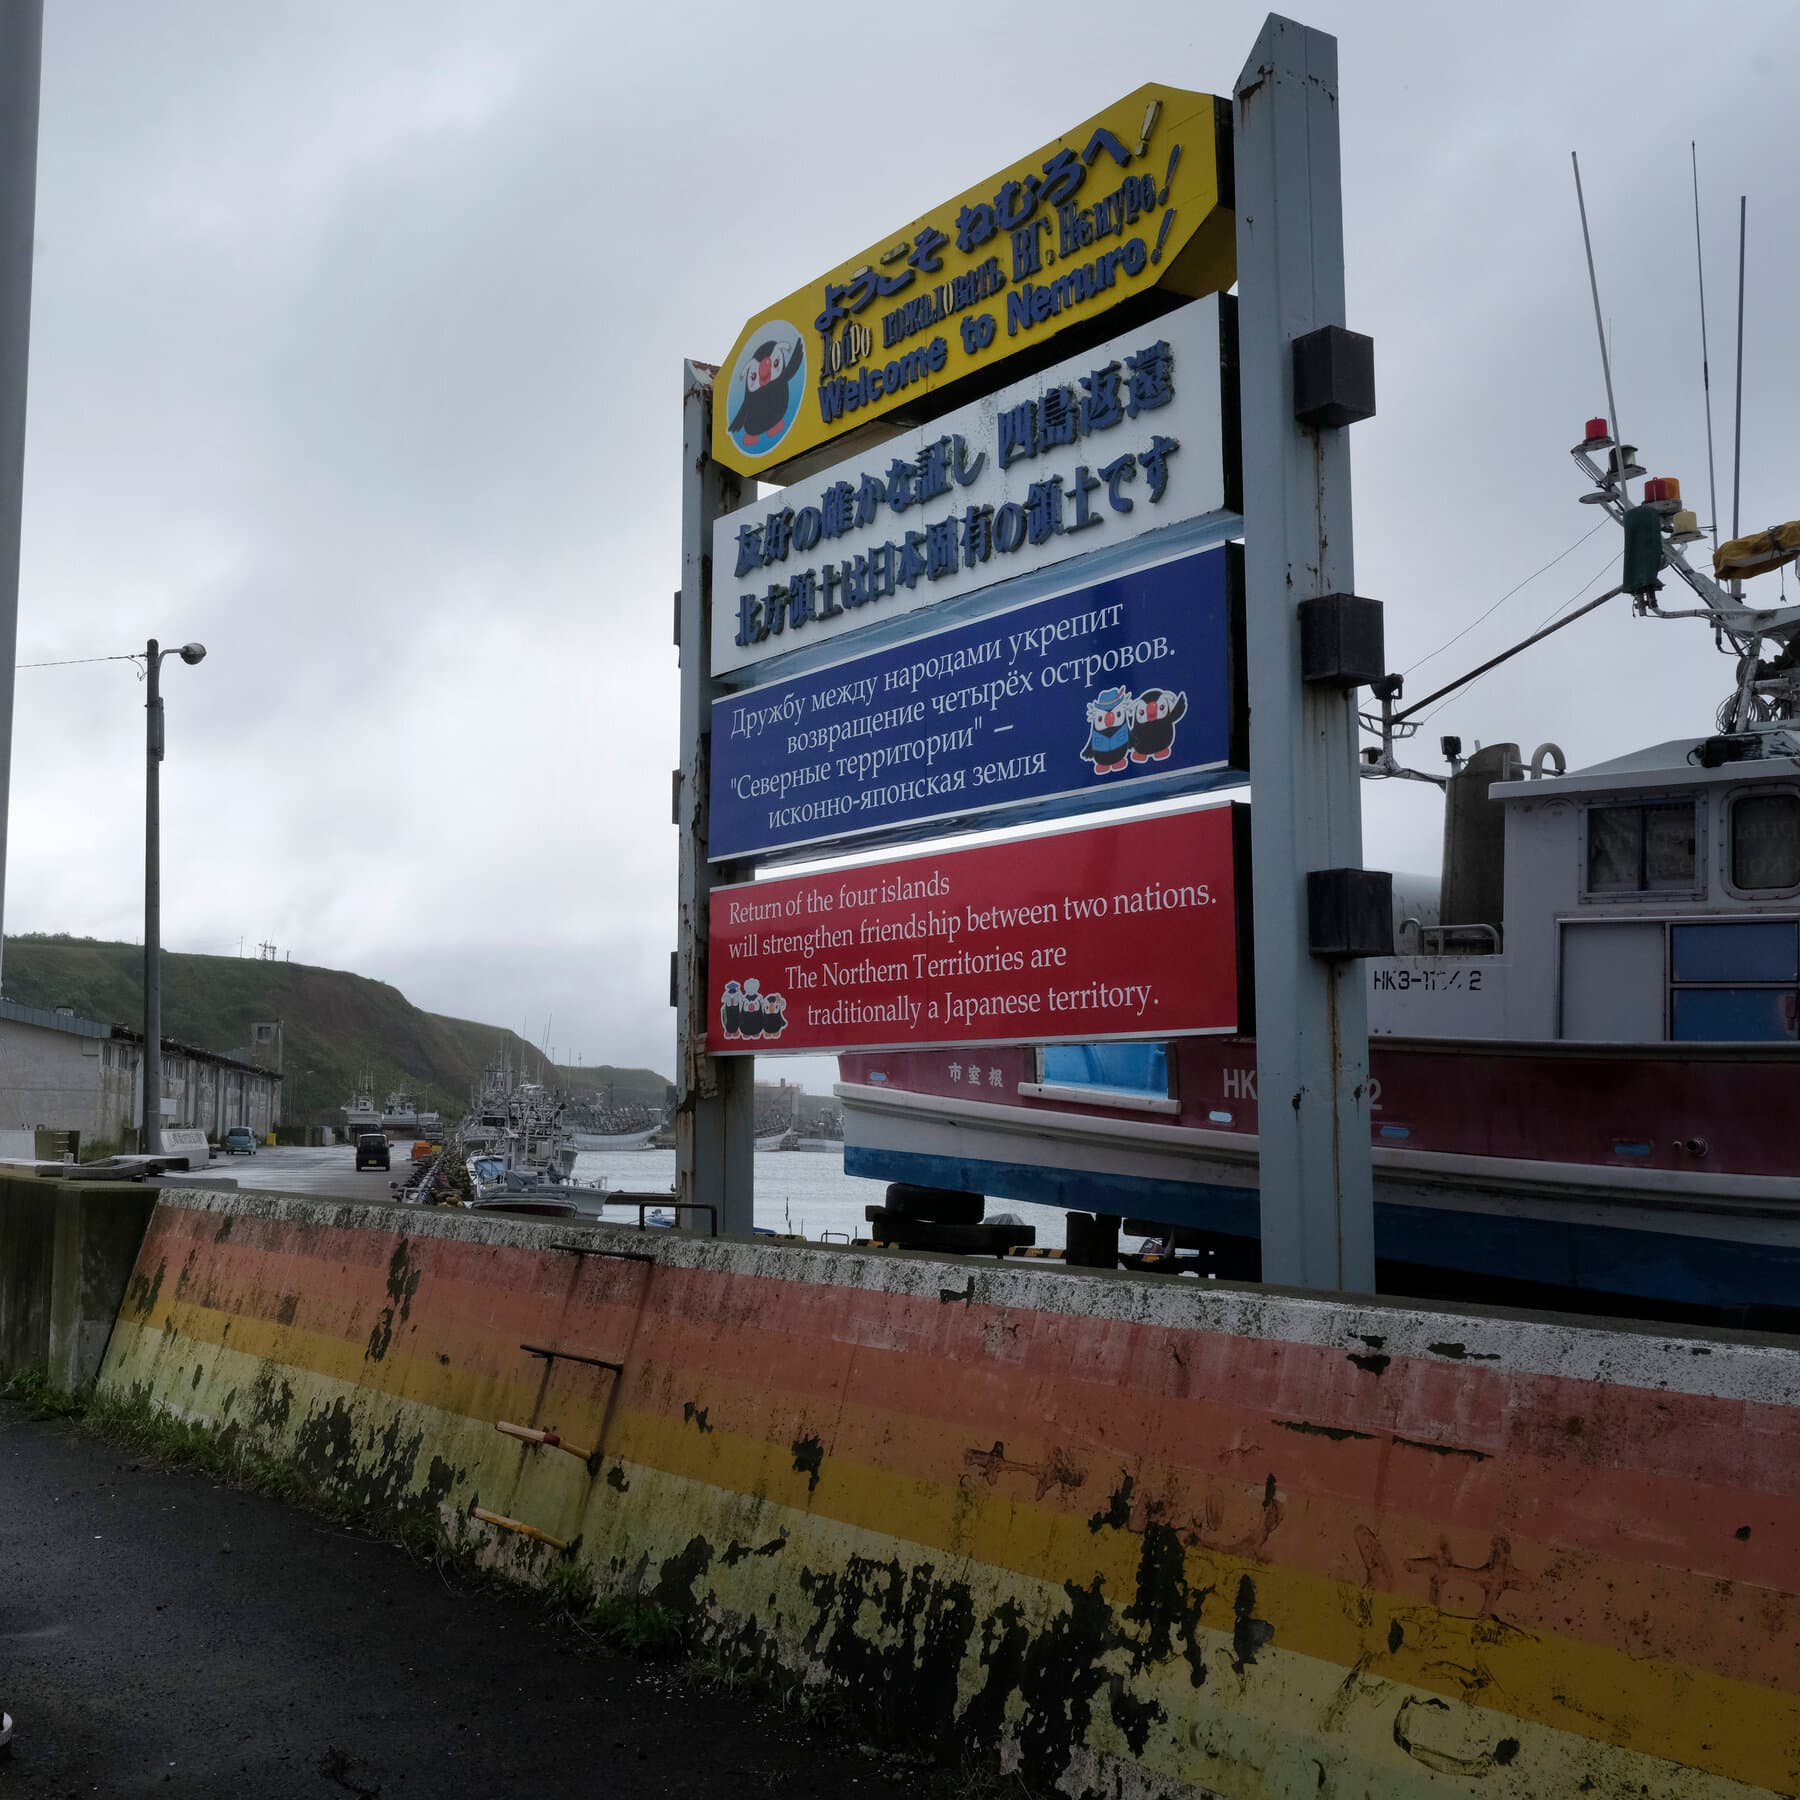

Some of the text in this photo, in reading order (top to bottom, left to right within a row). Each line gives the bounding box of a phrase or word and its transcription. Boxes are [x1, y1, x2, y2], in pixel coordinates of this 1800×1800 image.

[814, 225, 950, 334] ようこそ
[817, 207, 1178, 424] Welcome to Nemuro!
[997, 340, 1177, 472] 四島返還
[734, 436, 1181, 647] 北方領土は日本固有の領土です
[730, 603, 1123, 739] Дружбу между народами укрепит
[787, 637, 1175, 754] возвращение четырёх островов.
[731, 762, 831, 800] "Северные
[836, 716, 982, 782] территории"
[769, 752, 1046, 829] исконно-японская земля
[729, 869, 950, 925] Return of the four islands
[729, 881, 1217, 959] will strengthen friendship between two nations.
[785, 945, 1067, 990] The Northern Territories are
[807, 981, 1159, 1029] traditionally a Japanese territory.
